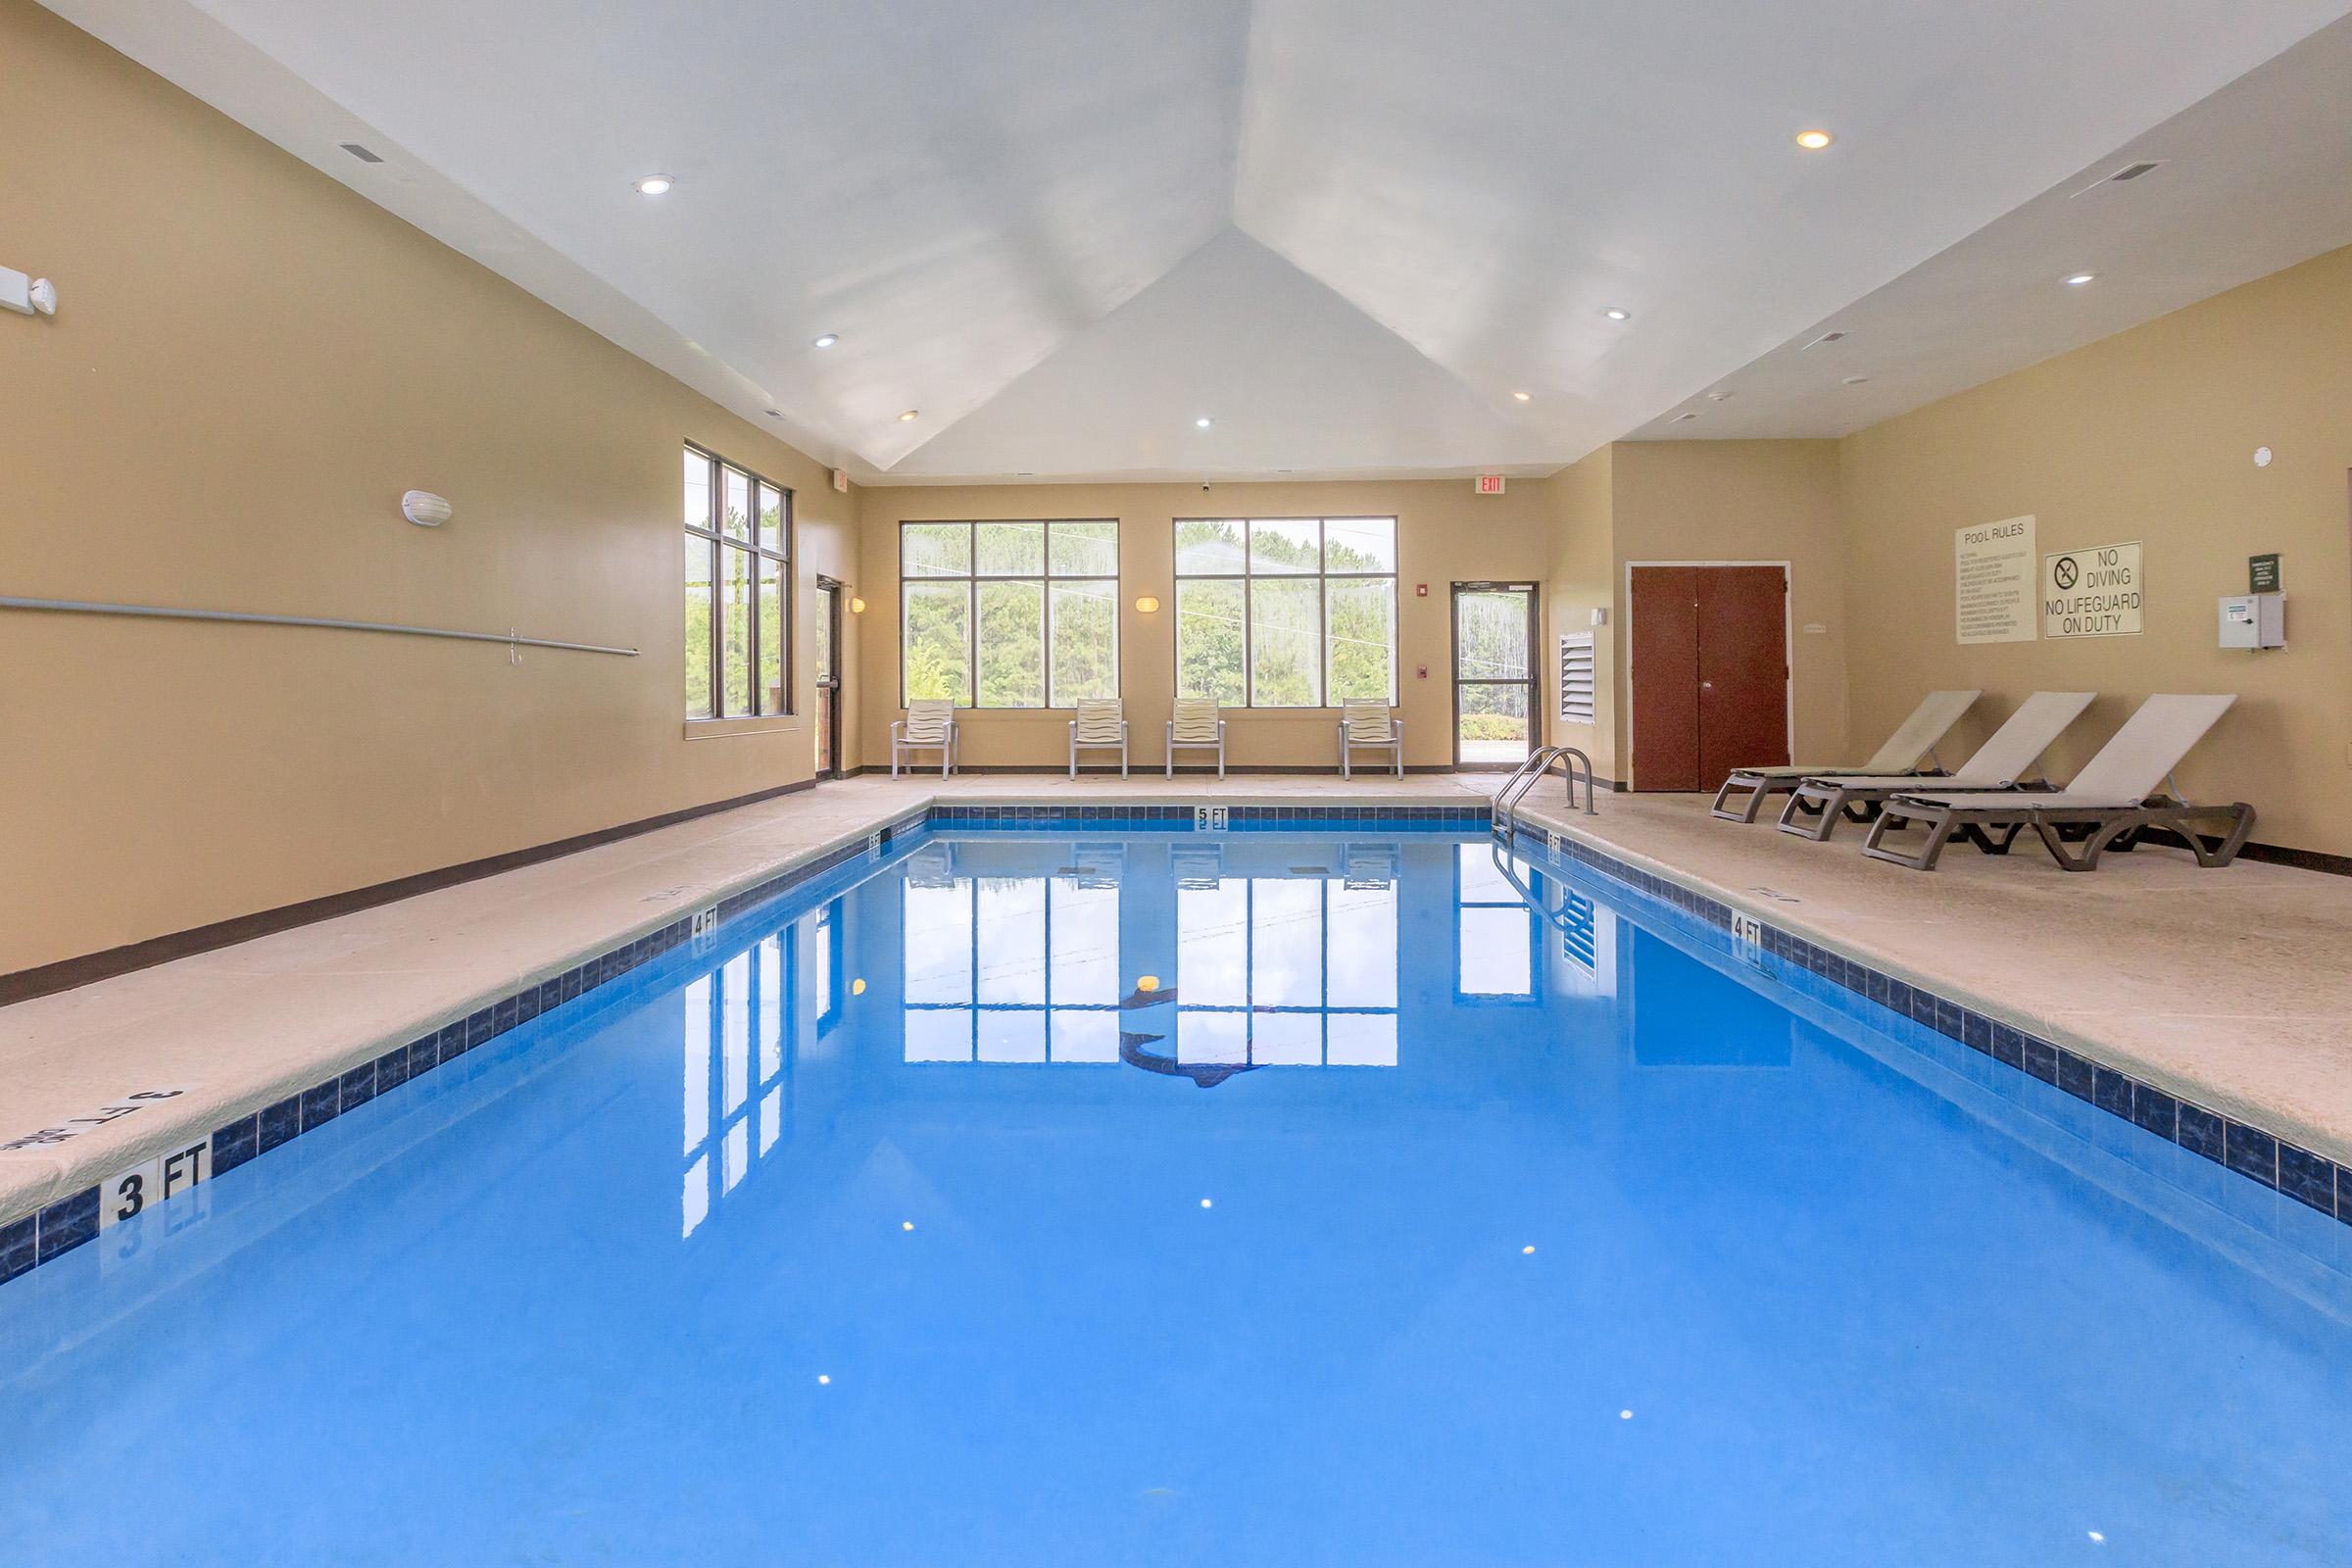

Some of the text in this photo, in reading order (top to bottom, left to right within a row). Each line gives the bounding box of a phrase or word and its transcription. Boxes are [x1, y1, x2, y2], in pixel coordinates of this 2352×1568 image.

[1482, 476, 1500, 492] EXIT
[1965, 522, 2025, 545] POOL RULES
[2097, 549, 2119, 566] NO
[2086, 567, 2132, 588] DIVING
[2046, 592, 2140, 615] NO LIFEGUARD
[2063, 614, 2122, 634] ON DUTY
[1199, 808, 1207, 819] 5
[695, 907, 716, 933] 4 FT
[1735, 916, 1759, 945] 4 FT
[118, 1142, 207, 1222] 3 FT
